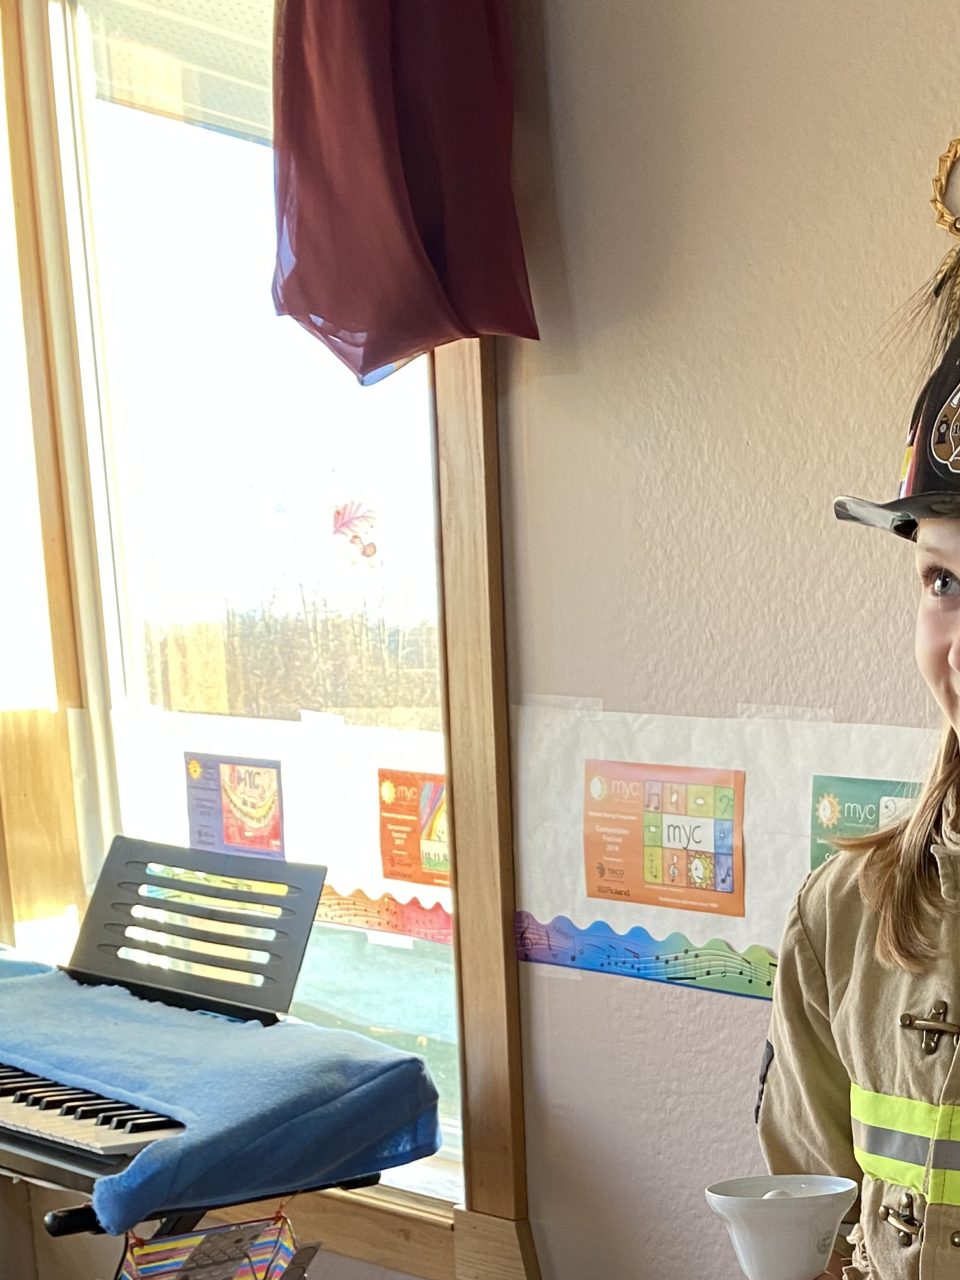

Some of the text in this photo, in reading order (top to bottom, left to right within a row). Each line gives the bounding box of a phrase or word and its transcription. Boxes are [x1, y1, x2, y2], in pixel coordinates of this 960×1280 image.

[611, 780, 640, 798] myc
[844, 802, 876, 822] myc
[667, 824, 702, 850] myc
